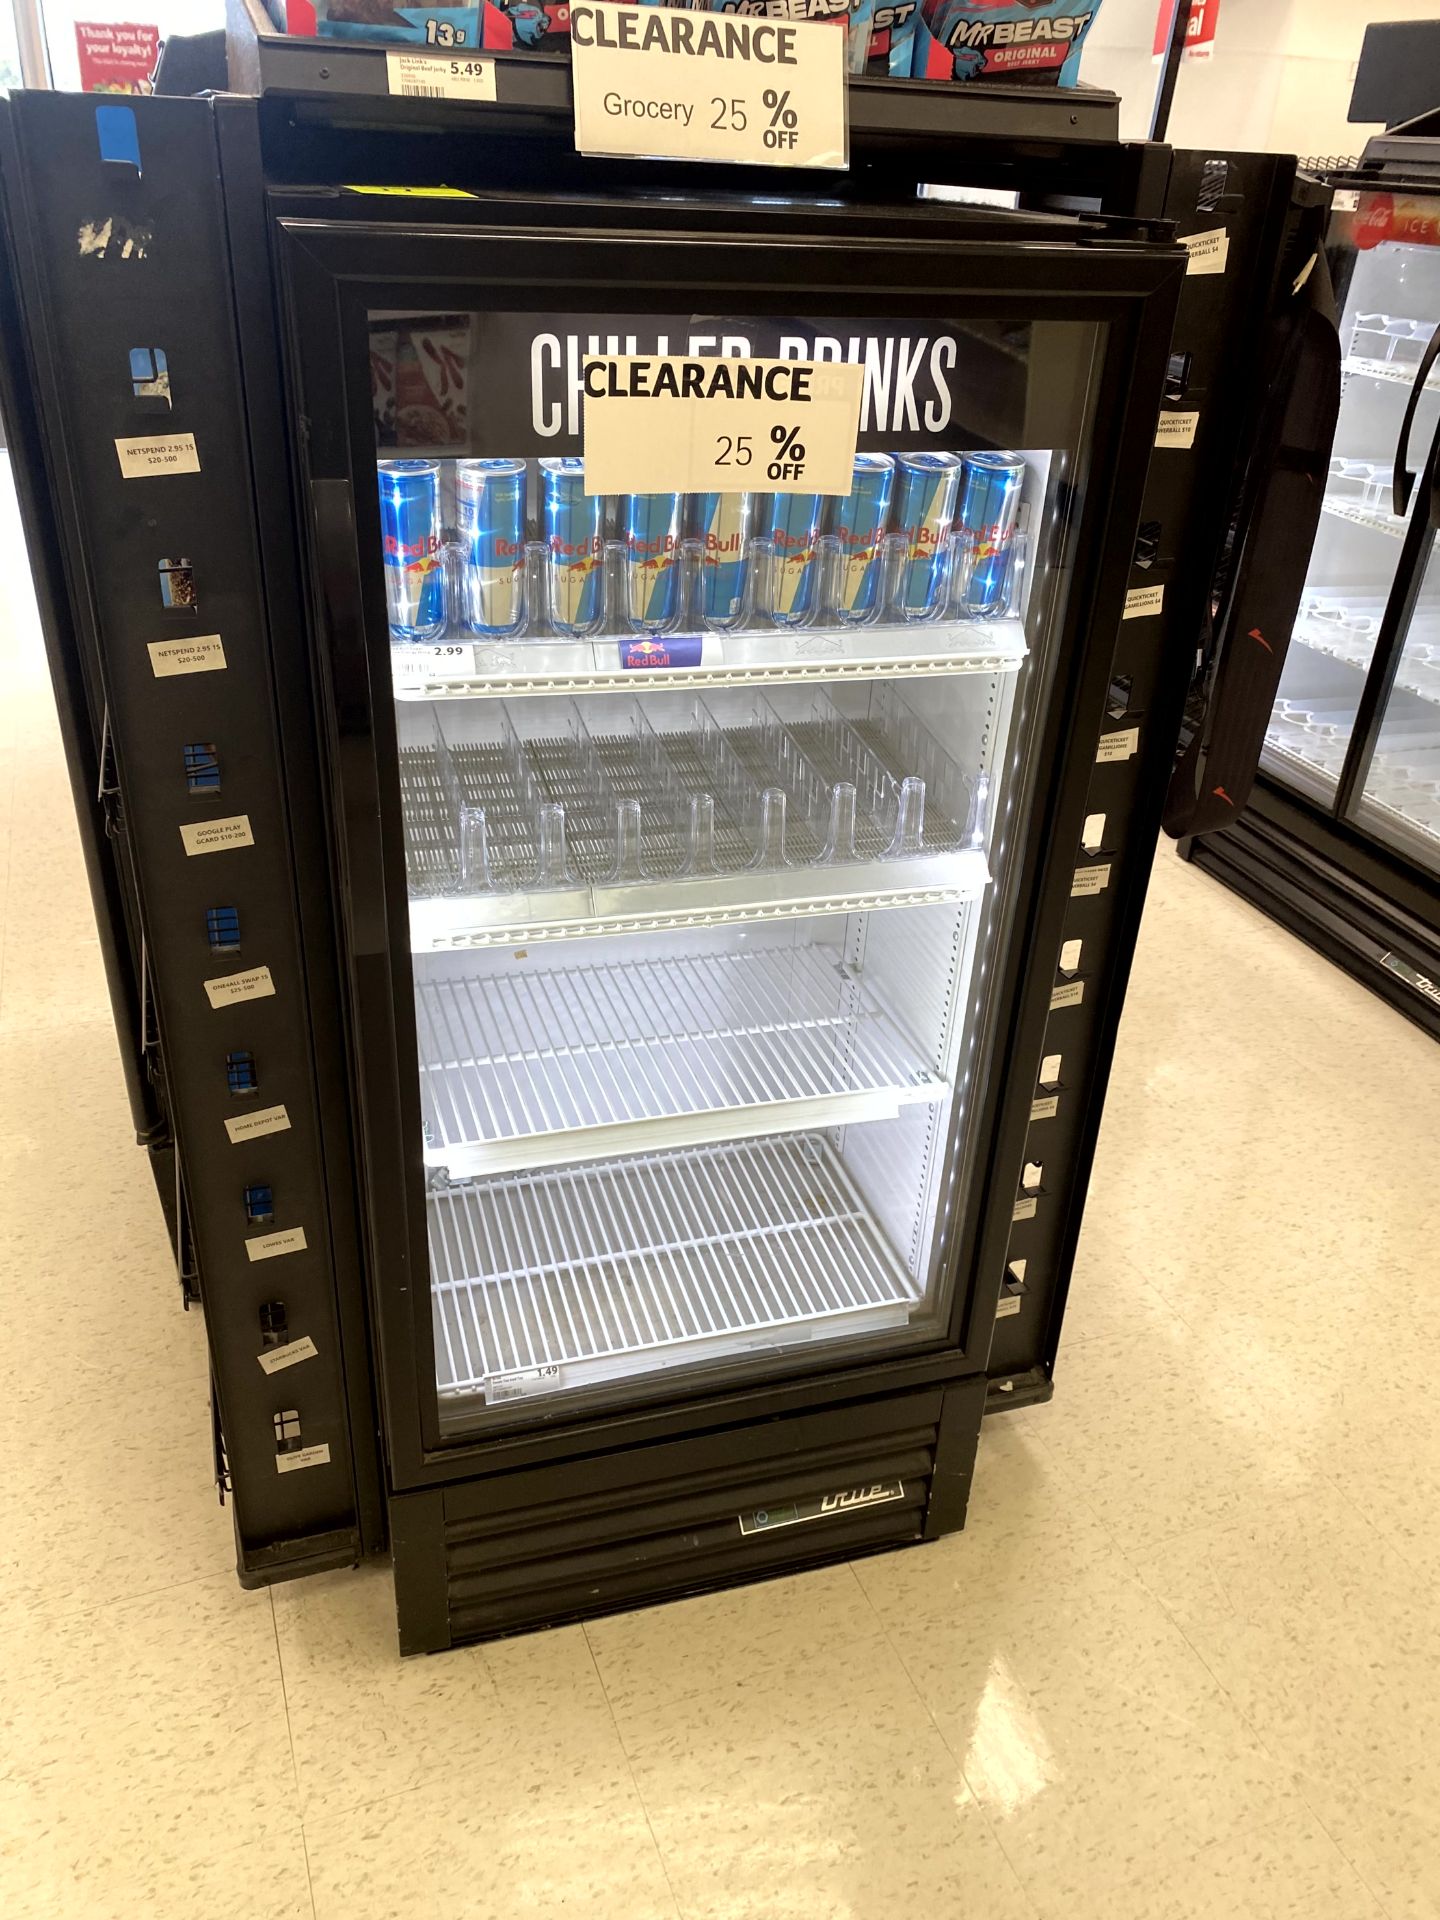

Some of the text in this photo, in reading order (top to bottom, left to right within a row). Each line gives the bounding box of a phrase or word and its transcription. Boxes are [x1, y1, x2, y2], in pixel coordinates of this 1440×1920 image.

[80, 26, 153, 43] Thank you for
[570, 7, 798, 65] CLEARANCE
[86, 42, 152, 58] your loyalty!
[993, 46, 1057, 63] ORIGINAL
[400, 64, 420, 72] Original
[450, 62, 483, 76] 5.49
[603, 89, 798, 132] Grocery 25 %
[763, 129, 799, 150] OFF
[1404, 218, 1429, 234] ICE
[583, 360, 813, 402] CLEARANCE
[127, 446, 166, 456] NETSPEND
[168, 444, 184, 453] 2.95
[714, 425, 806, 466] 25 %
[148, 455, 178, 464] $20-500
[767, 462, 806, 481] OFF
[626, 529, 661, 554] Red
[705, 533, 740, 552] Bull
[773, 528, 809, 547] Red
[838, 526, 873, 545] Red
[385, 534, 425, 557] Red
[550, 535, 589, 556] Red
[158, 647, 195, 657] NETSPEND
[196, 644, 211, 653] 2.95
[434, 646, 463, 656] 2.99
[178, 654, 205, 664] $20-500
[627, 653, 670, 667] Red Bull
[197, 824, 241, 837] GOOGLE PLAY
[196, 836, 219, 845] GCARD
[235, 1123, 253, 1132] HOME
[254, 1117, 273, 1127] DEPOT
[537, 1365, 558, 1377] 1.49
